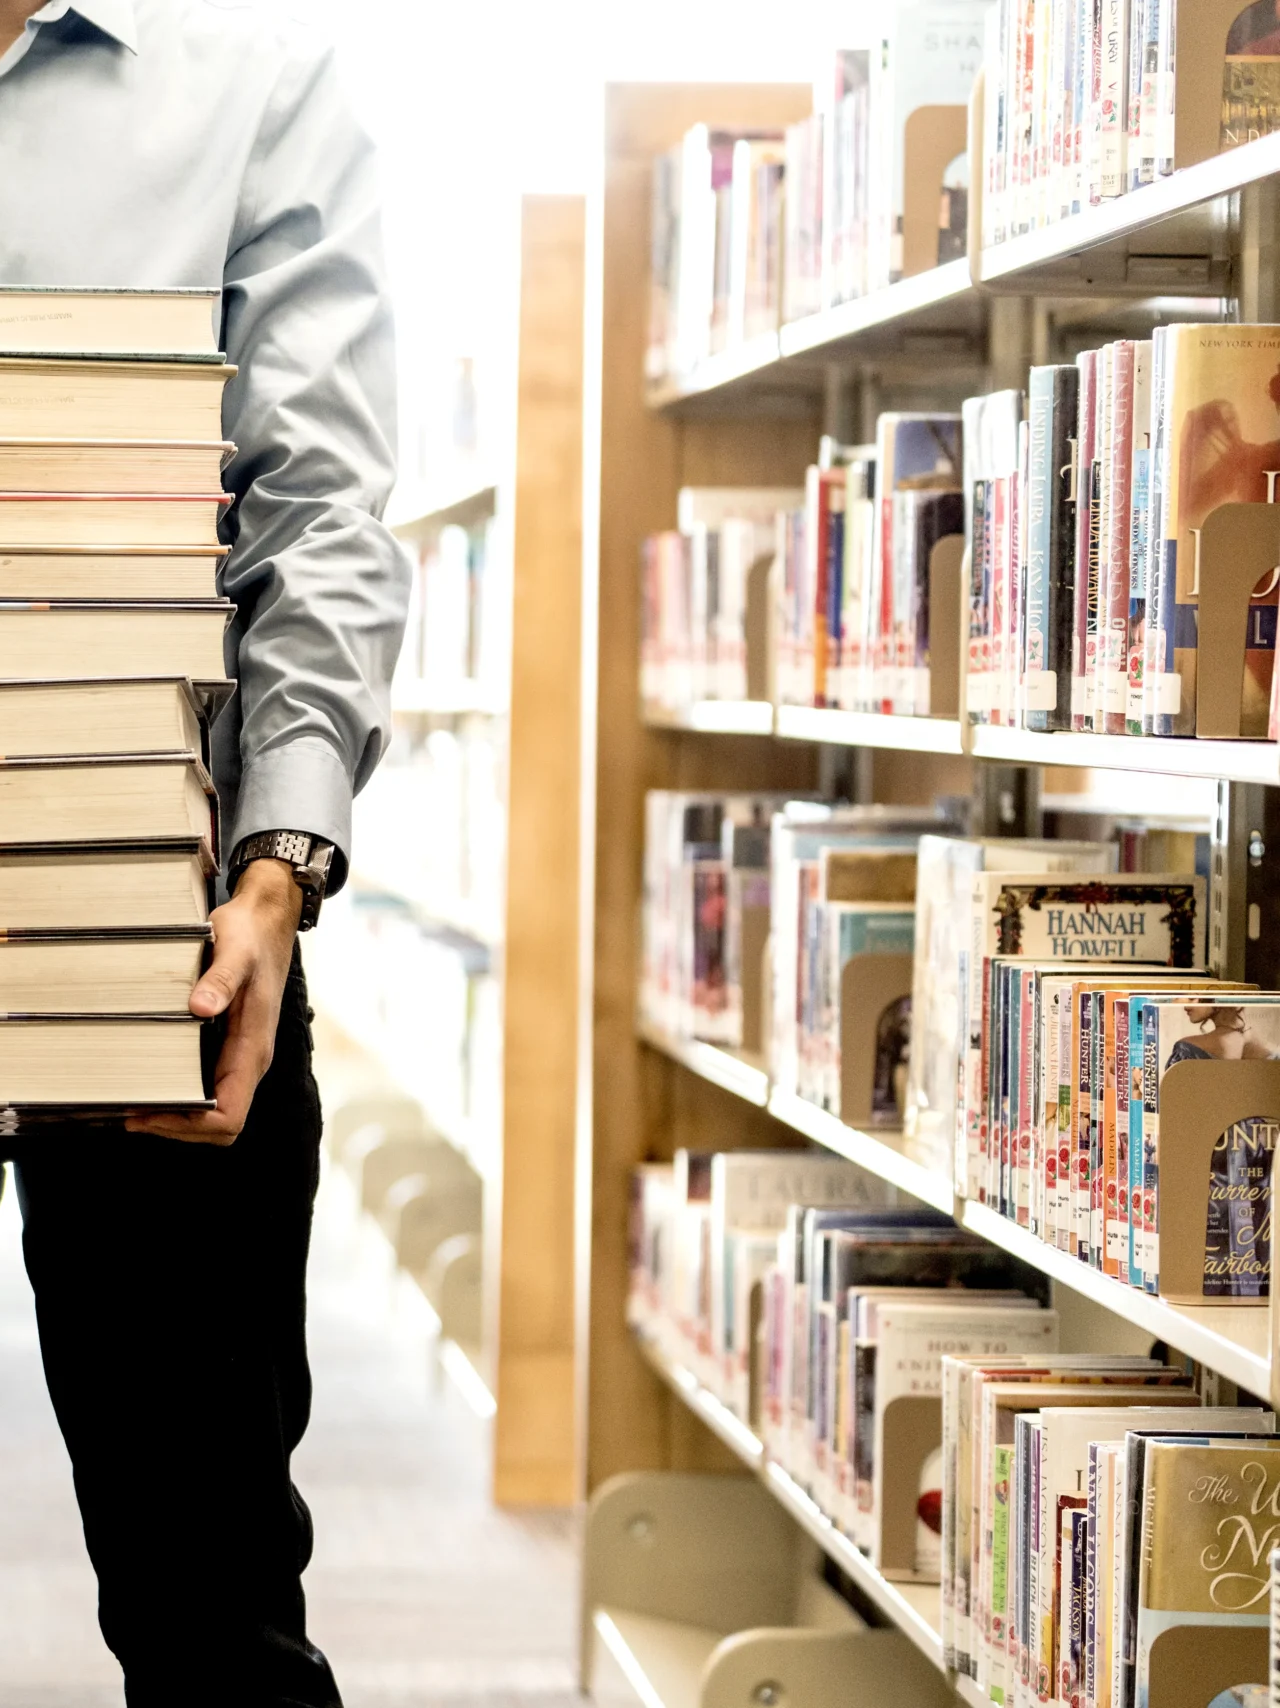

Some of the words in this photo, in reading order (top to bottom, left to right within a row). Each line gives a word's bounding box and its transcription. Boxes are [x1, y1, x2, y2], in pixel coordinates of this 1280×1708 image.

[1108, 31, 1119, 64] GRAY
[1199, 340, 1222, 348] NEW
[1226, 340, 1253, 348] YORK
[1113, 349, 1130, 452] LINDA
[1032, 395, 1050, 471] FINDING
[1030, 475, 1047, 526] LAURA
[1090, 500, 1101, 543] LINDA
[1131, 507, 1141, 544] LINDA
[1109, 462, 1126, 602] HOWARD
[1029, 549, 1045, 595] KAY
[1088, 548, 1099, 612] HOWARD
[1130, 549, 1140, 589] JONES
[1047, 909, 1146, 936] HANNAH
[1050, 1016, 1060, 1056] JILLIAN
[1061, 1021, 1071, 1077] HUNTER
[1080, 1028, 1090, 1084] HUNTER
[1049, 1059, 1059, 1100] HUNTER
[1116, 1041, 1124, 1100] HUNTER
[1144, 1044, 1152, 1105] HUNTER
[1150, 1041, 1158, 1109] MADELINE
[1108, 1122, 1116, 1175] MADELIN
[1133, 1137, 1141, 1185] MADELIN
[1238, 1166, 1264, 1177] THE
[1239, 1207, 1255, 1217] OF
[927, 1340, 970, 1353] HOW
[982, 1341, 1008, 1354] TO
[1088, 1459, 1098, 1518] ANNA
[1188, 1474, 1239, 1504] The
[1030, 1552, 1038, 1604] BLACK
[1087, 1535, 1097, 1626] JACOBS
[1071, 1581, 1081, 1640] JACKSON
